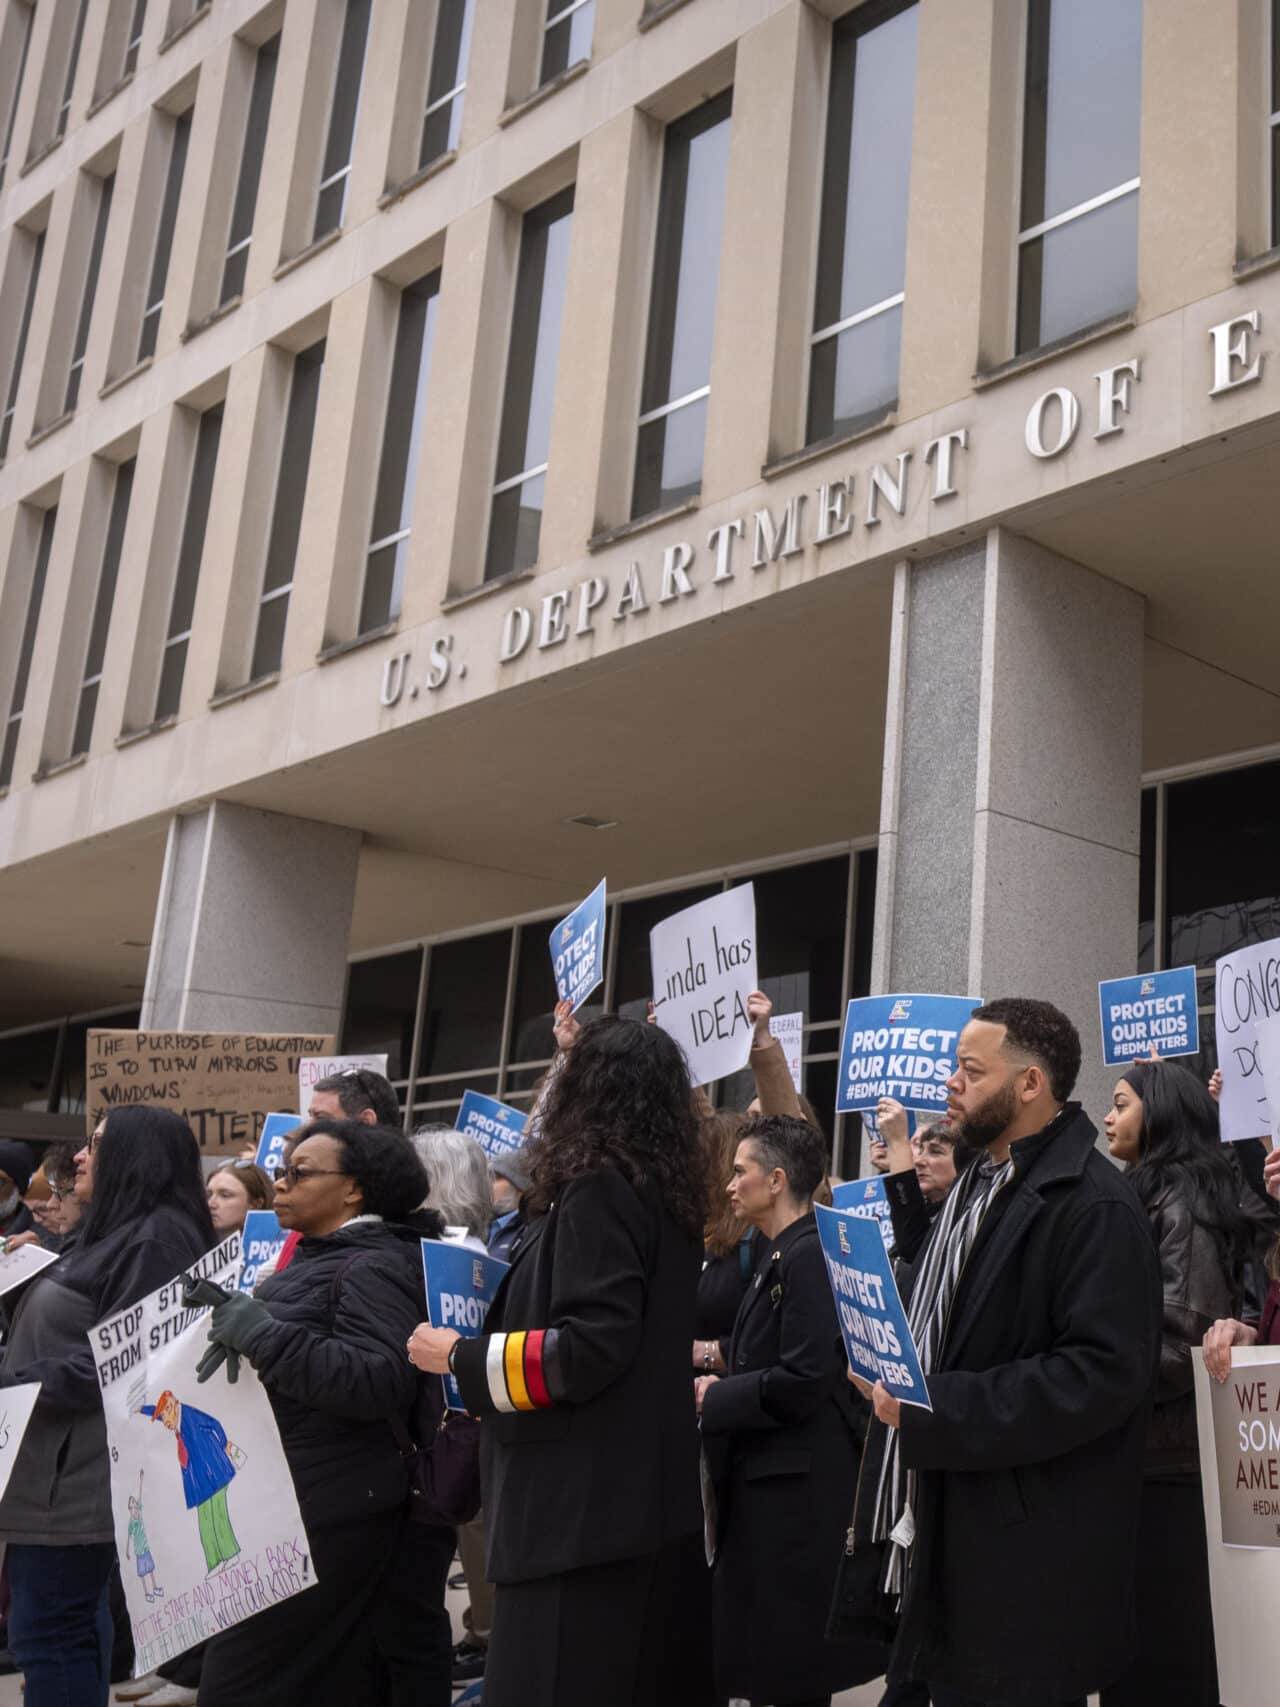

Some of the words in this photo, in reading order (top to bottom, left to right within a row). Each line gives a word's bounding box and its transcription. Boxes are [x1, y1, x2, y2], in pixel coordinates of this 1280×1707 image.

[380, 634, 467, 708] U.S.
[499, 427, 970, 664] DEPARTMENT
[1024, 357, 1142, 459] OF
[556, 918, 598, 977] OTECT
[712, 925, 753, 975] has
[691, 990, 750, 1047] IDEA
[1110, 994, 1185, 1022] PROTECT
[852, 1027, 957, 1054] PROTECT
[1111, 1022, 1147, 1042] OUR
[1149, 1015, 1187, 1037] KIDS
[91, 1034, 121, 1056] THE
[137, 1034, 215, 1051] PURPOSE
[222, 1038, 241, 1050] OF
[245, 1037, 325, 1052] EDUCATION
[1113, 1034, 1188, 1056] #EDMATTERS
[90, 1063, 107, 1079] IS
[117, 1061, 139, 1075] TO
[149, 1056, 197, 1072] TURN
[208, 1057, 278, 1073] MIRRORS
[848, 1055, 885, 1080] OUR
[886, 1054, 952, 1080] KIDS
[846, 1080, 949, 1101] #EDMATTERS
[99, 1306, 143, 1351] STOP
[98, 1338, 142, 1389] FROM
[1235, 1382, 1268, 1413] WE
[218, 1554, 261, 1597] MONEY
[265, 1536, 304, 1570] BACK
[245, 1577, 274, 1612] OUR
